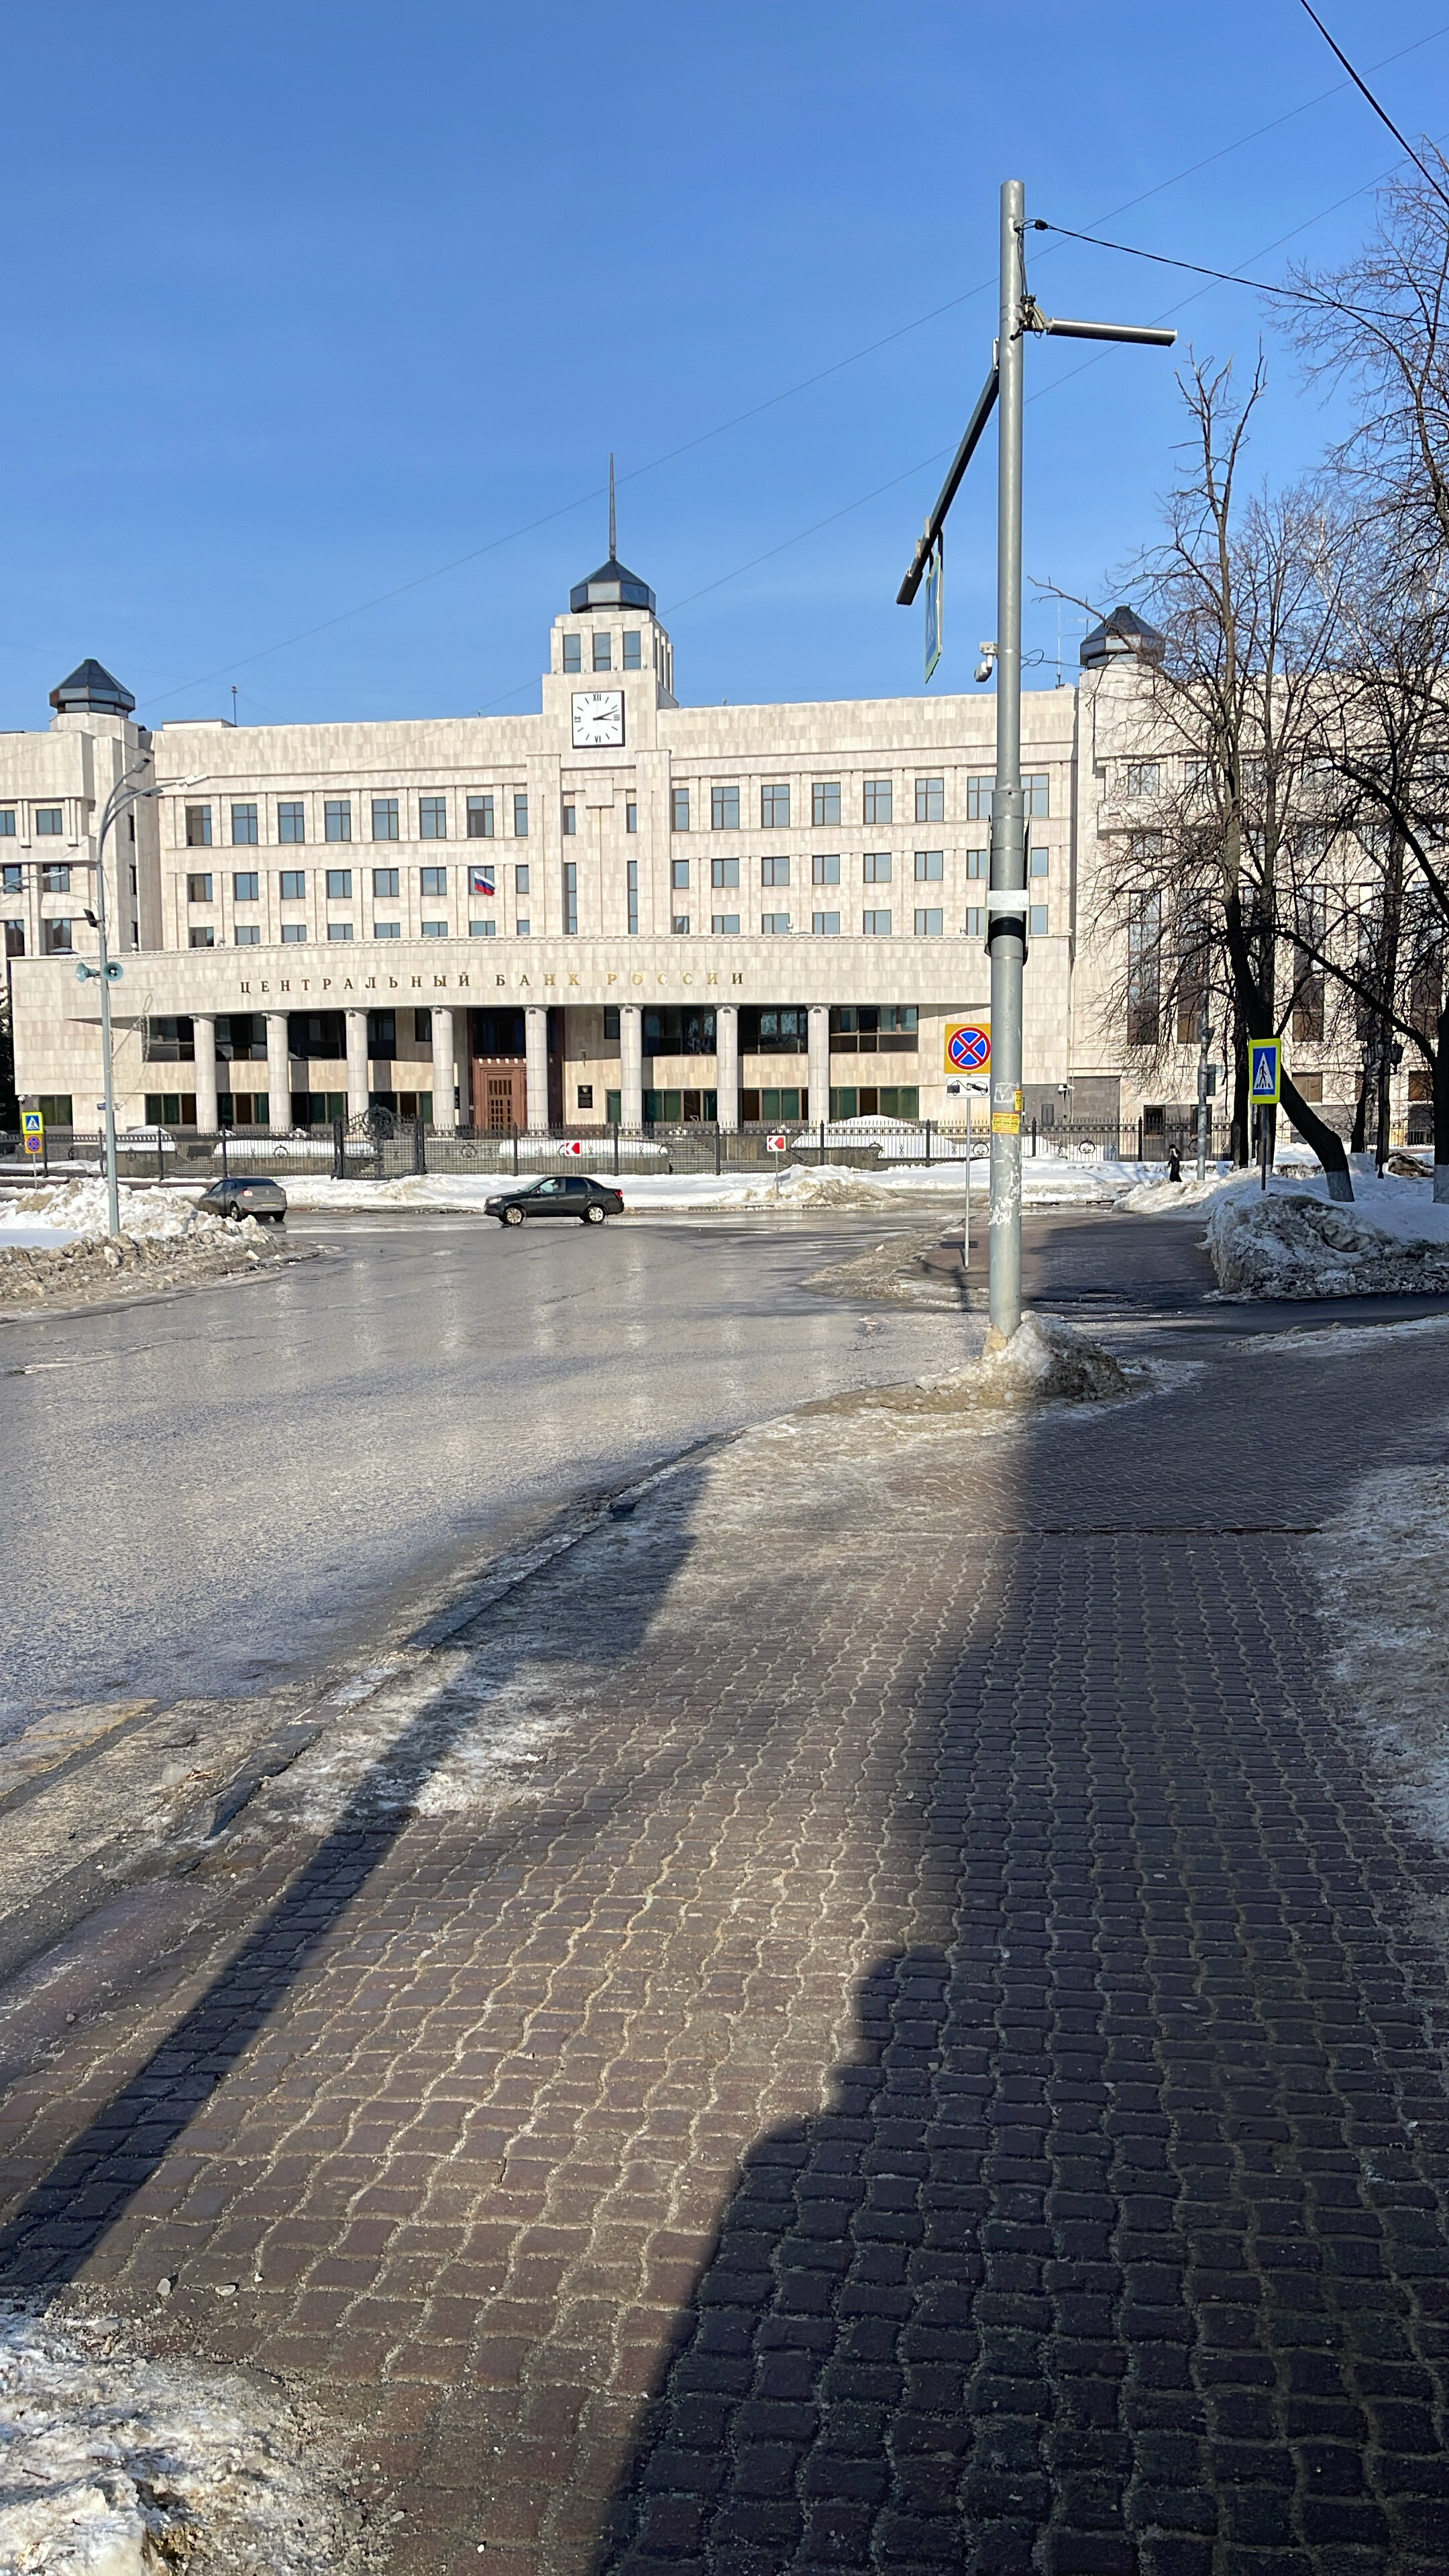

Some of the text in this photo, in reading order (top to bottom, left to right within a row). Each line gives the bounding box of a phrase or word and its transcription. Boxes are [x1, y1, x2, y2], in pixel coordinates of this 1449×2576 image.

[594, 735, 601, 743] VI
[240, 972, 744, 994] ЦЕНТРАЛЬНЫЙ БАНК РОССИИ
